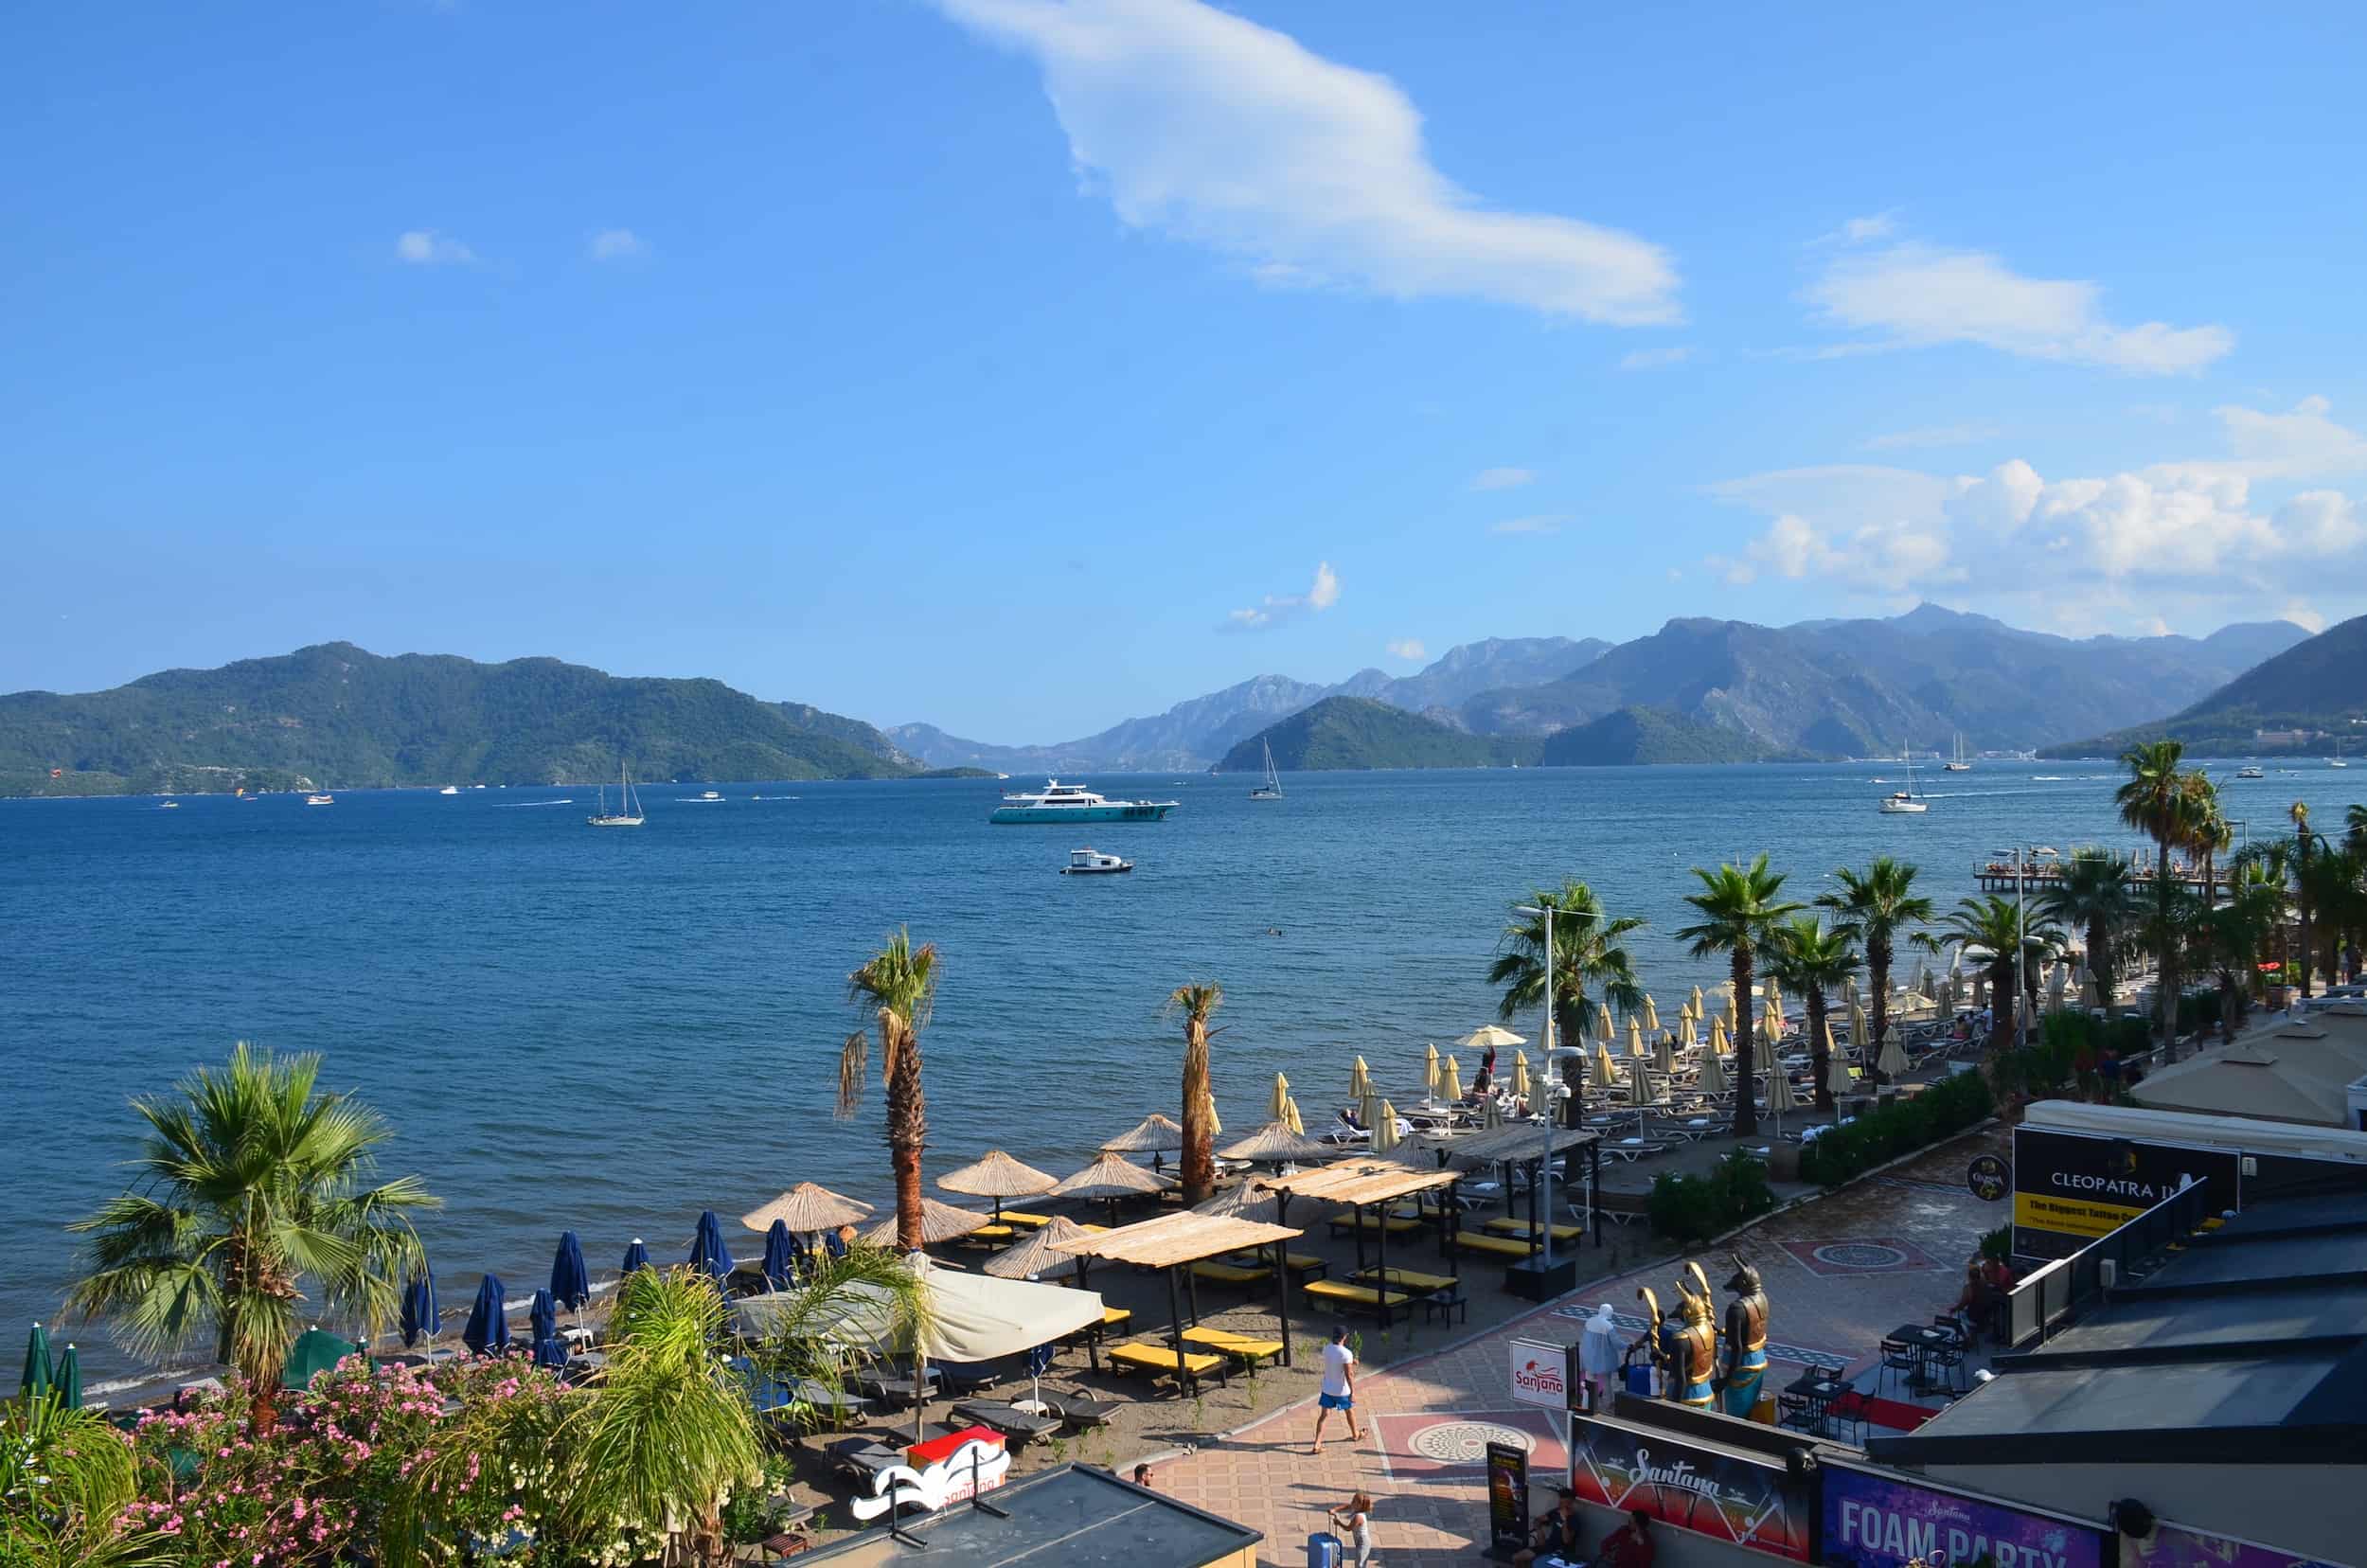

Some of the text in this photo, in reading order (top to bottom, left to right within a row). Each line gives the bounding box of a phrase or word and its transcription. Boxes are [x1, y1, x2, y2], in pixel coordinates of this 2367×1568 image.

[2052, 1172, 2154, 1198] CLEOPATRA
[1516, 1370, 1563, 1393] Sanjana
[1628, 1448, 1722, 1497] Santana
[1842, 1500, 1936, 1564] FOAM
